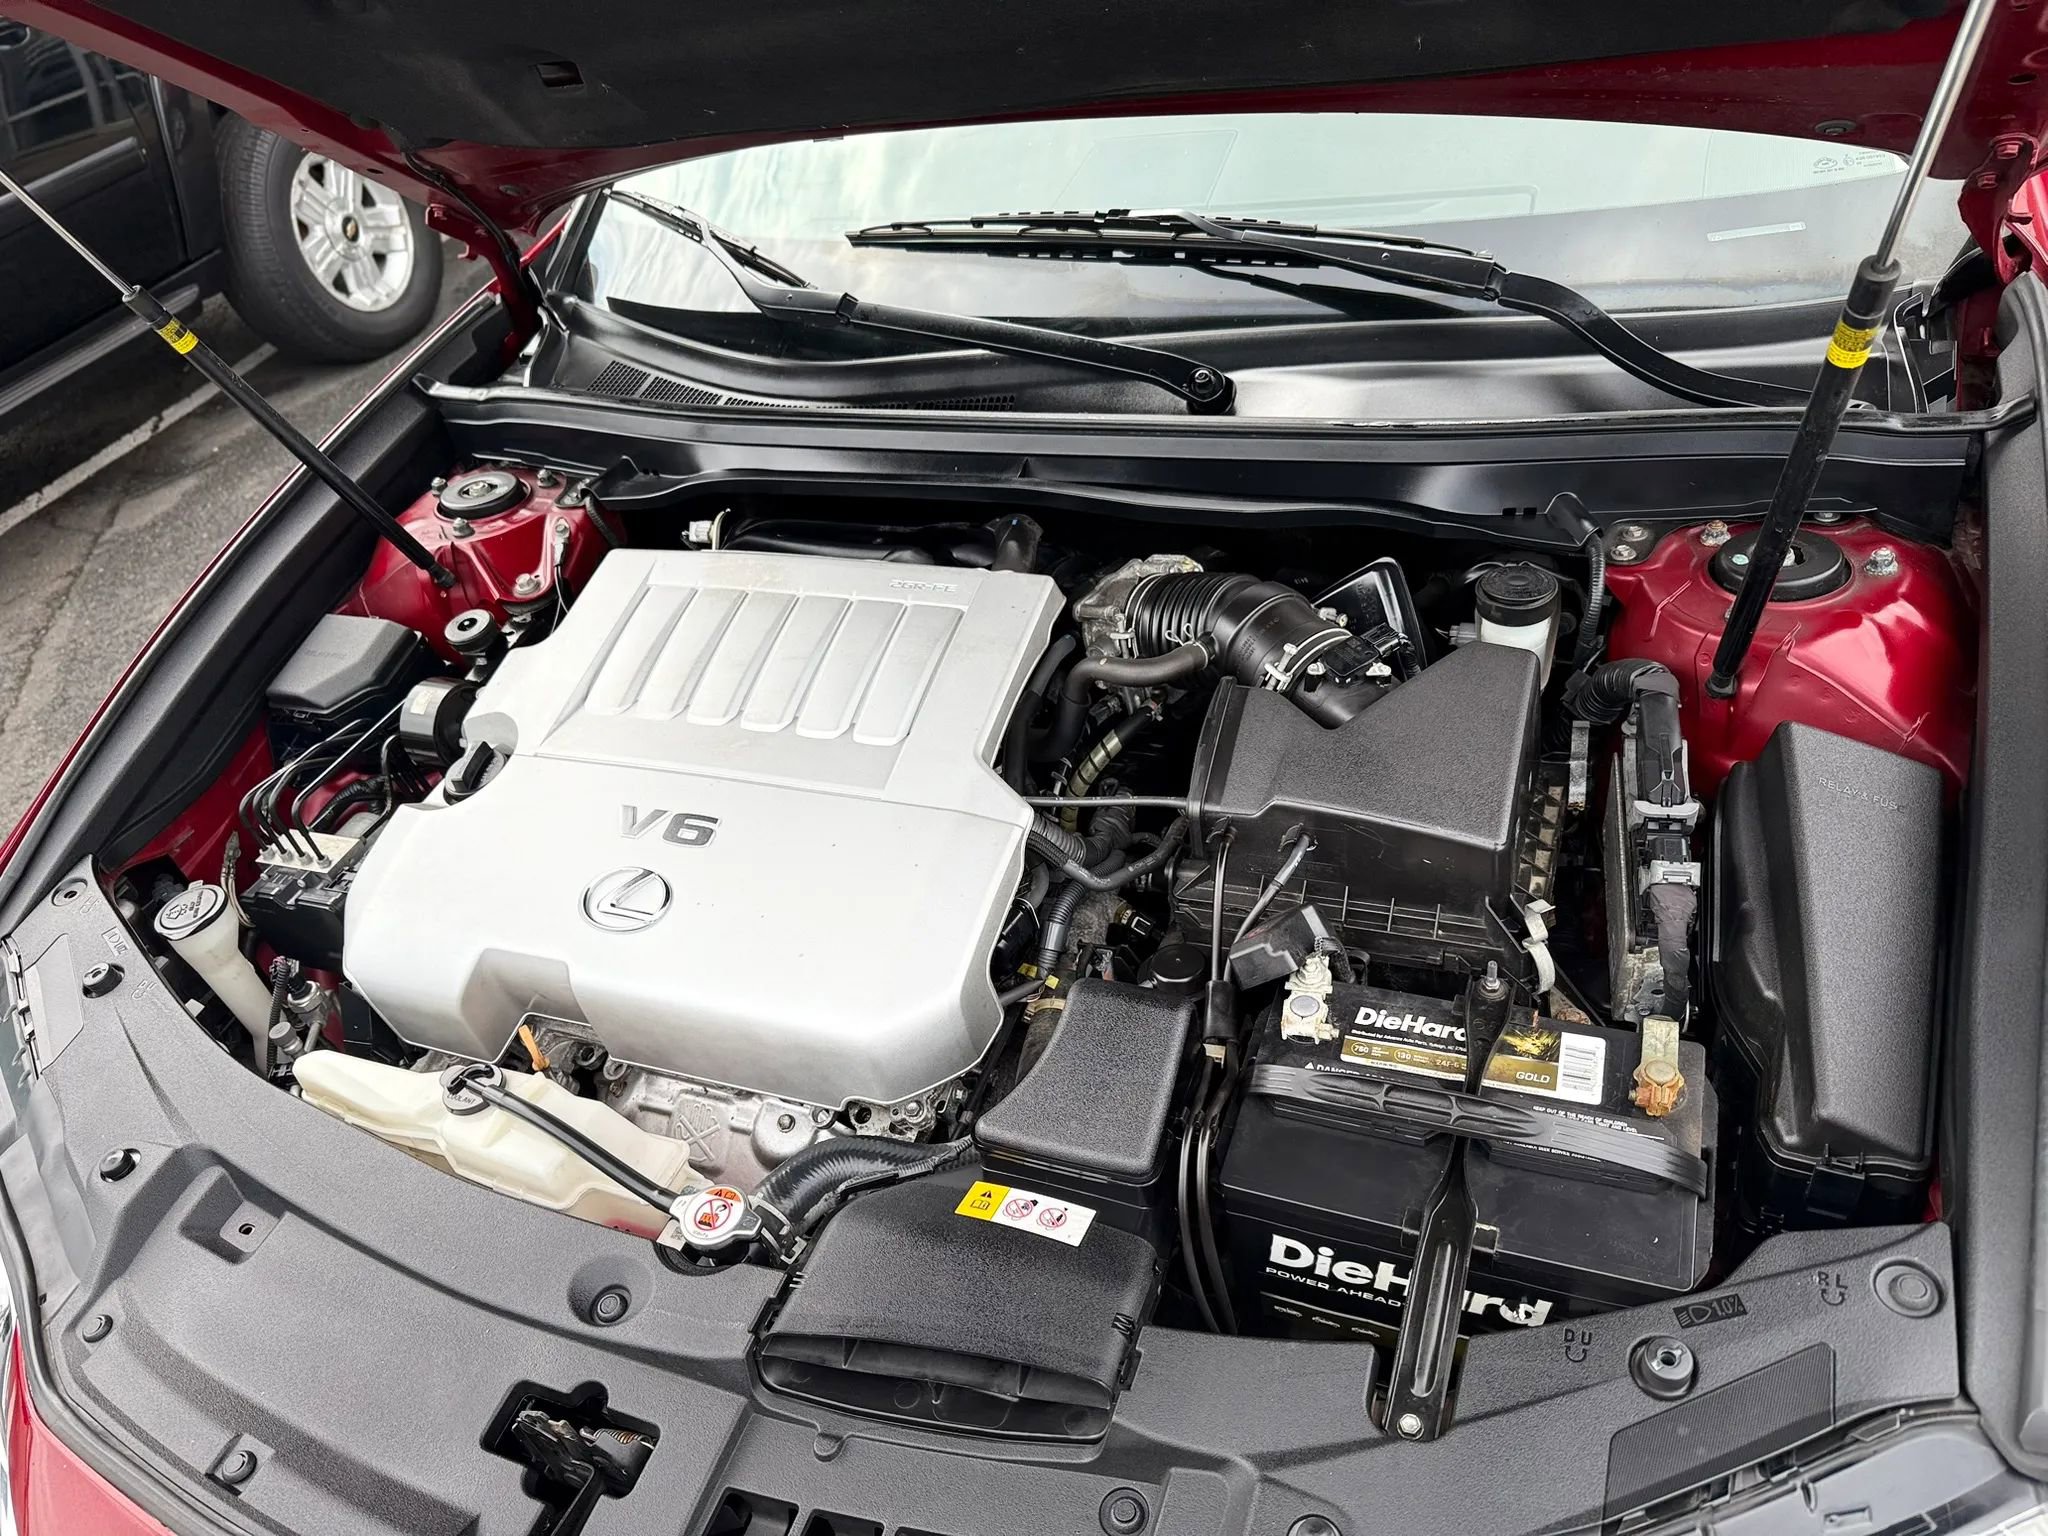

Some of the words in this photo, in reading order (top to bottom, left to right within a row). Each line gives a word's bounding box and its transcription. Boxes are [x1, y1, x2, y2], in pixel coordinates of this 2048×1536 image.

[1819, 777, 1859, 796] RELAY
[1873, 795, 1905, 813] FUSE
[620, 804, 720, 847] V6
[1516, 1071, 1551, 1084] GOLD
[1265, 1266, 1330, 1291] POWER
[1337, 1286, 1403, 1308] AHEAD
[1269, 1233, 1554, 1328] DieHrd
[1712, 1295, 1744, 1316] 1.0%
